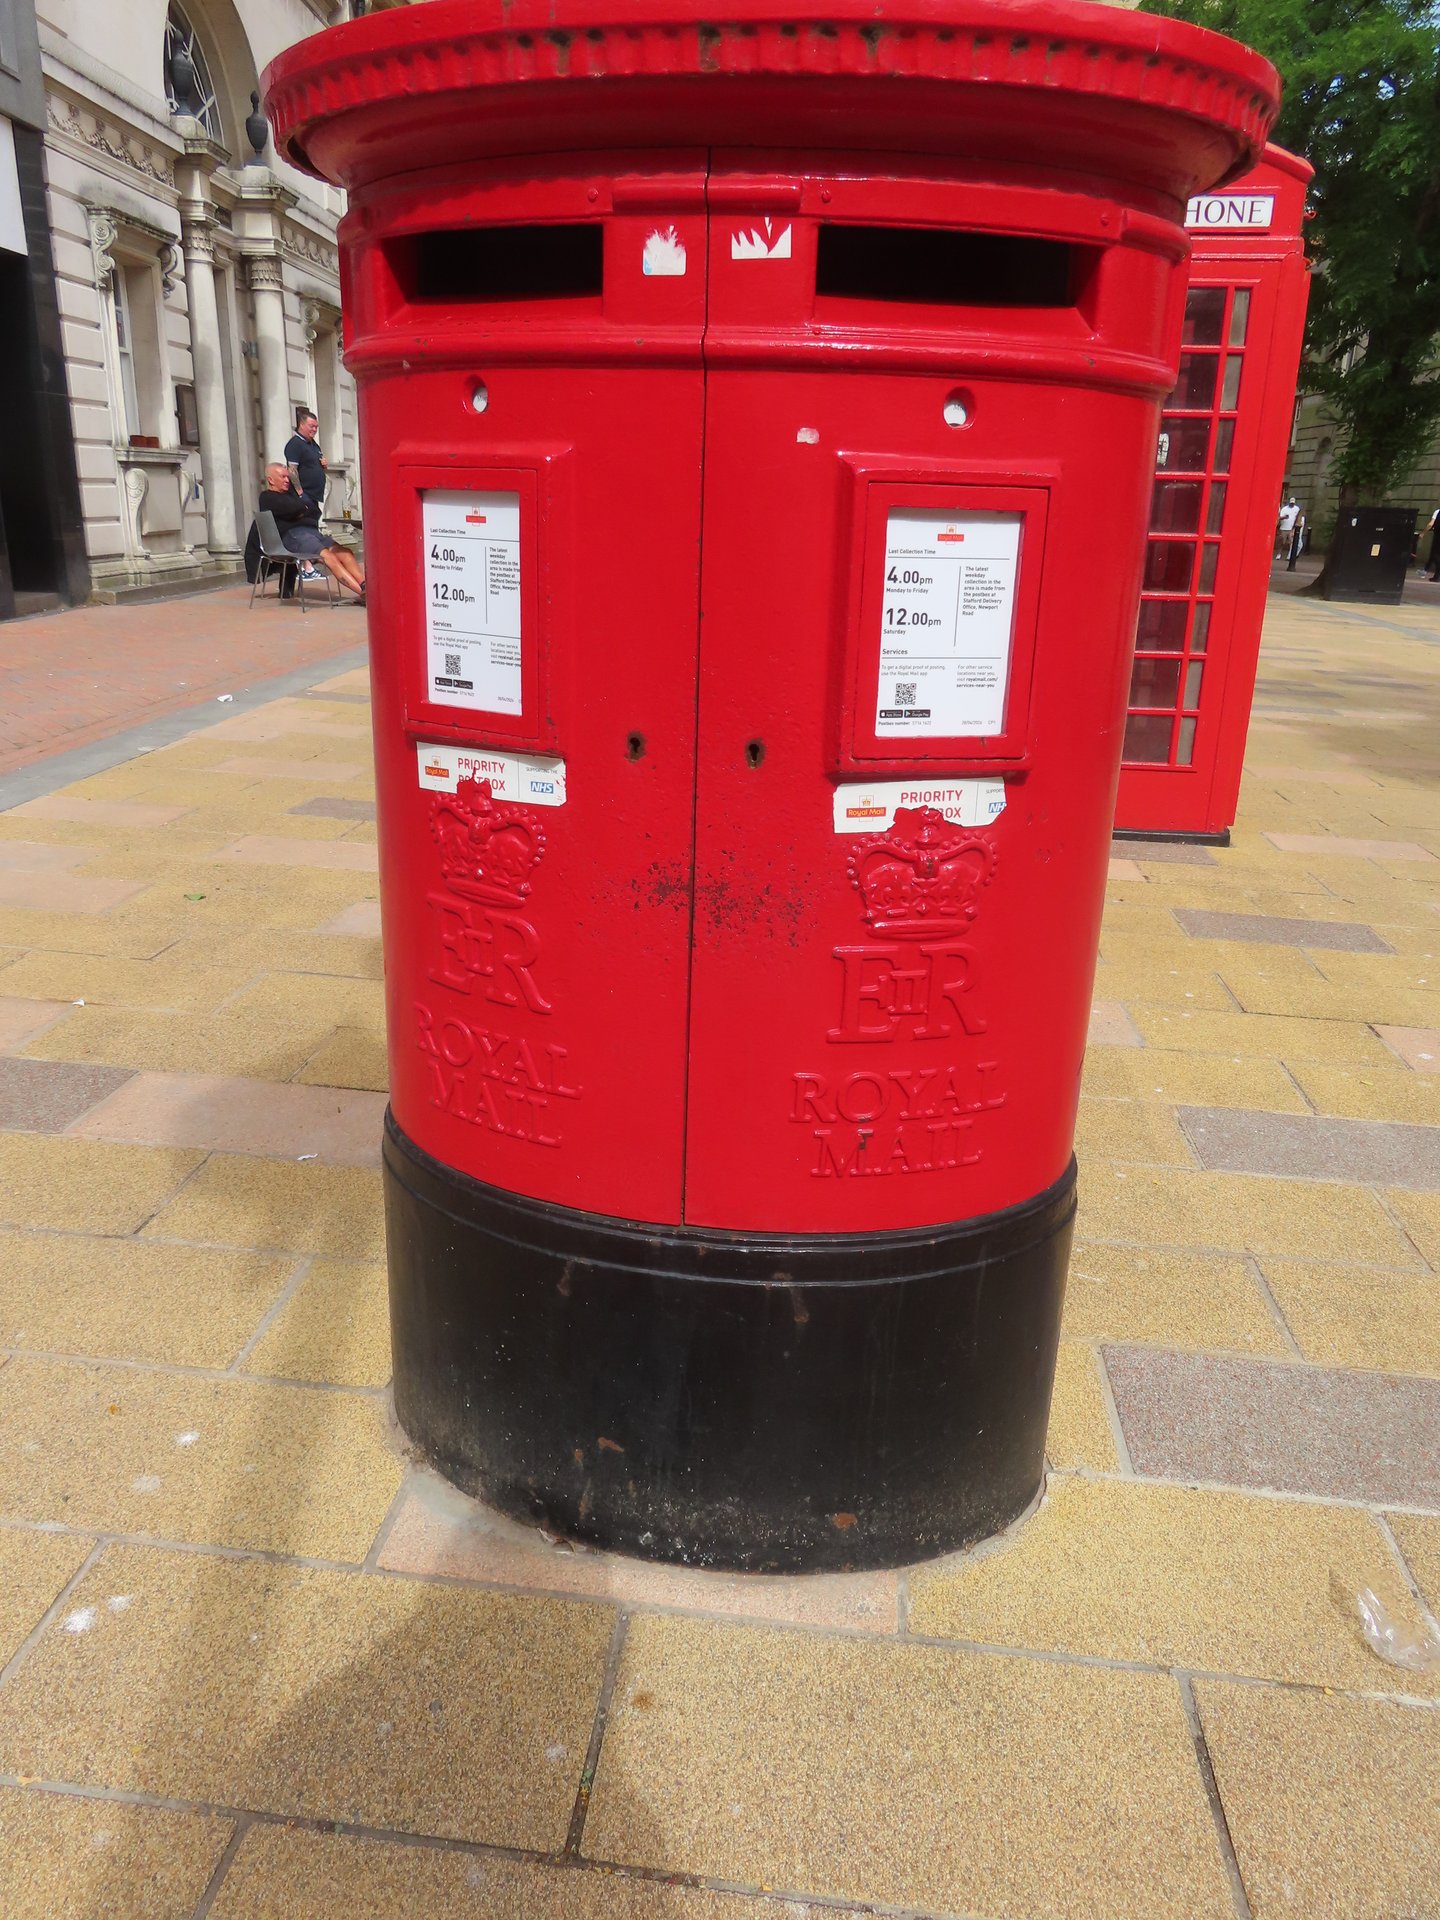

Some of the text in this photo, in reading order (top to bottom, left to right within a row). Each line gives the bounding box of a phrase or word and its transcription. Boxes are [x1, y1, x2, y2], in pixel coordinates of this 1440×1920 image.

[431, 544, 466, 563] 4.00pm
[887, 566, 933, 585] 4.00pm
[433, 583, 475, 603] 12.00pm
[886, 608, 941, 627] 12.00pm
[426, 767, 438, 776] Royal
[458, 758, 505, 773] PRIORITY
[532, 782, 552, 793] NHS
[900, 790, 963, 803] PRIORITY
[414, 1001, 583, 1100] ROYAL
[790, 1060, 1008, 1124] ROYAL
[428, 1058, 562, 1148] MAIL
[810, 1120, 983, 1178] MAIL
